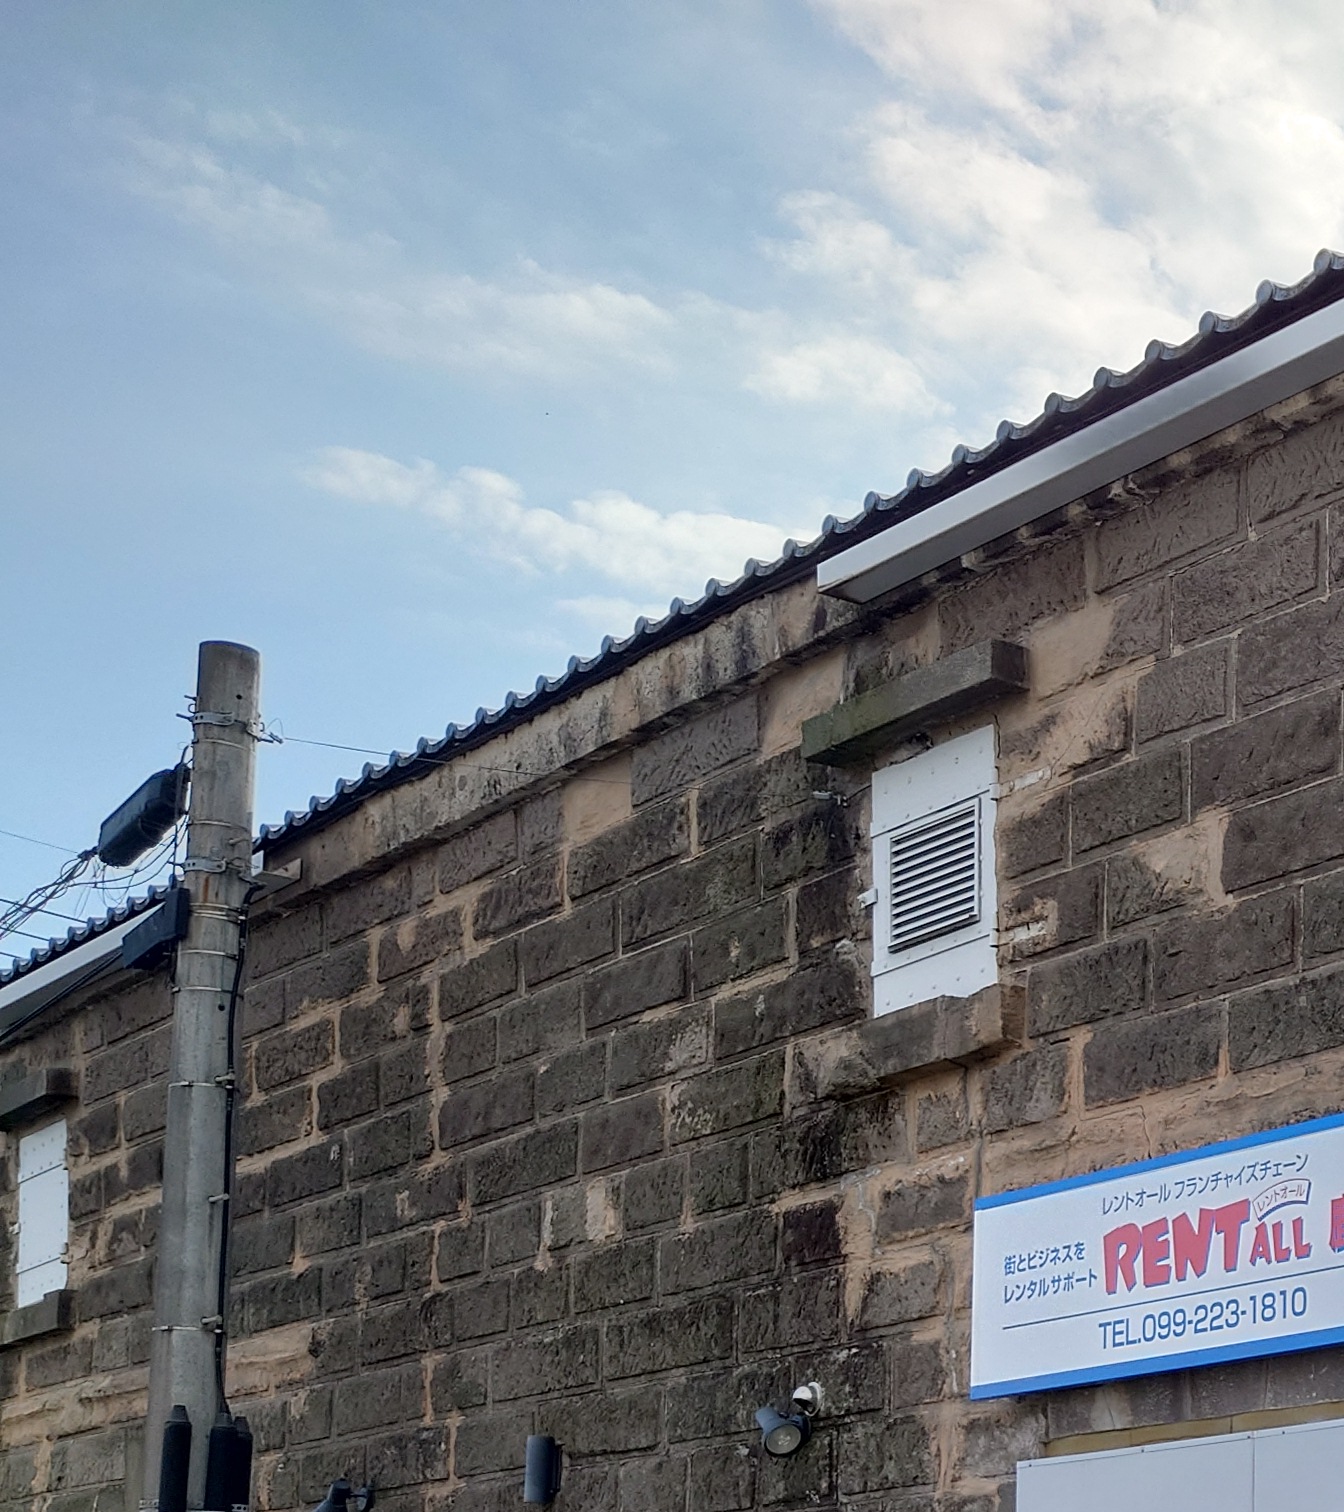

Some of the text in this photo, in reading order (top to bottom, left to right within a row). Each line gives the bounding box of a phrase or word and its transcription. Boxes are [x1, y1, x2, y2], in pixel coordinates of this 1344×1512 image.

[1102, 1154, 1309, 1216] レントオール フランチャイズチェーン
[1004, 1241, 1085, 1276] 街とビジネスを
[1003, 1269, 1098, 1304] レンタルサポート
[1098, 1287, 1308, 1350] TEL.099-223-1810
